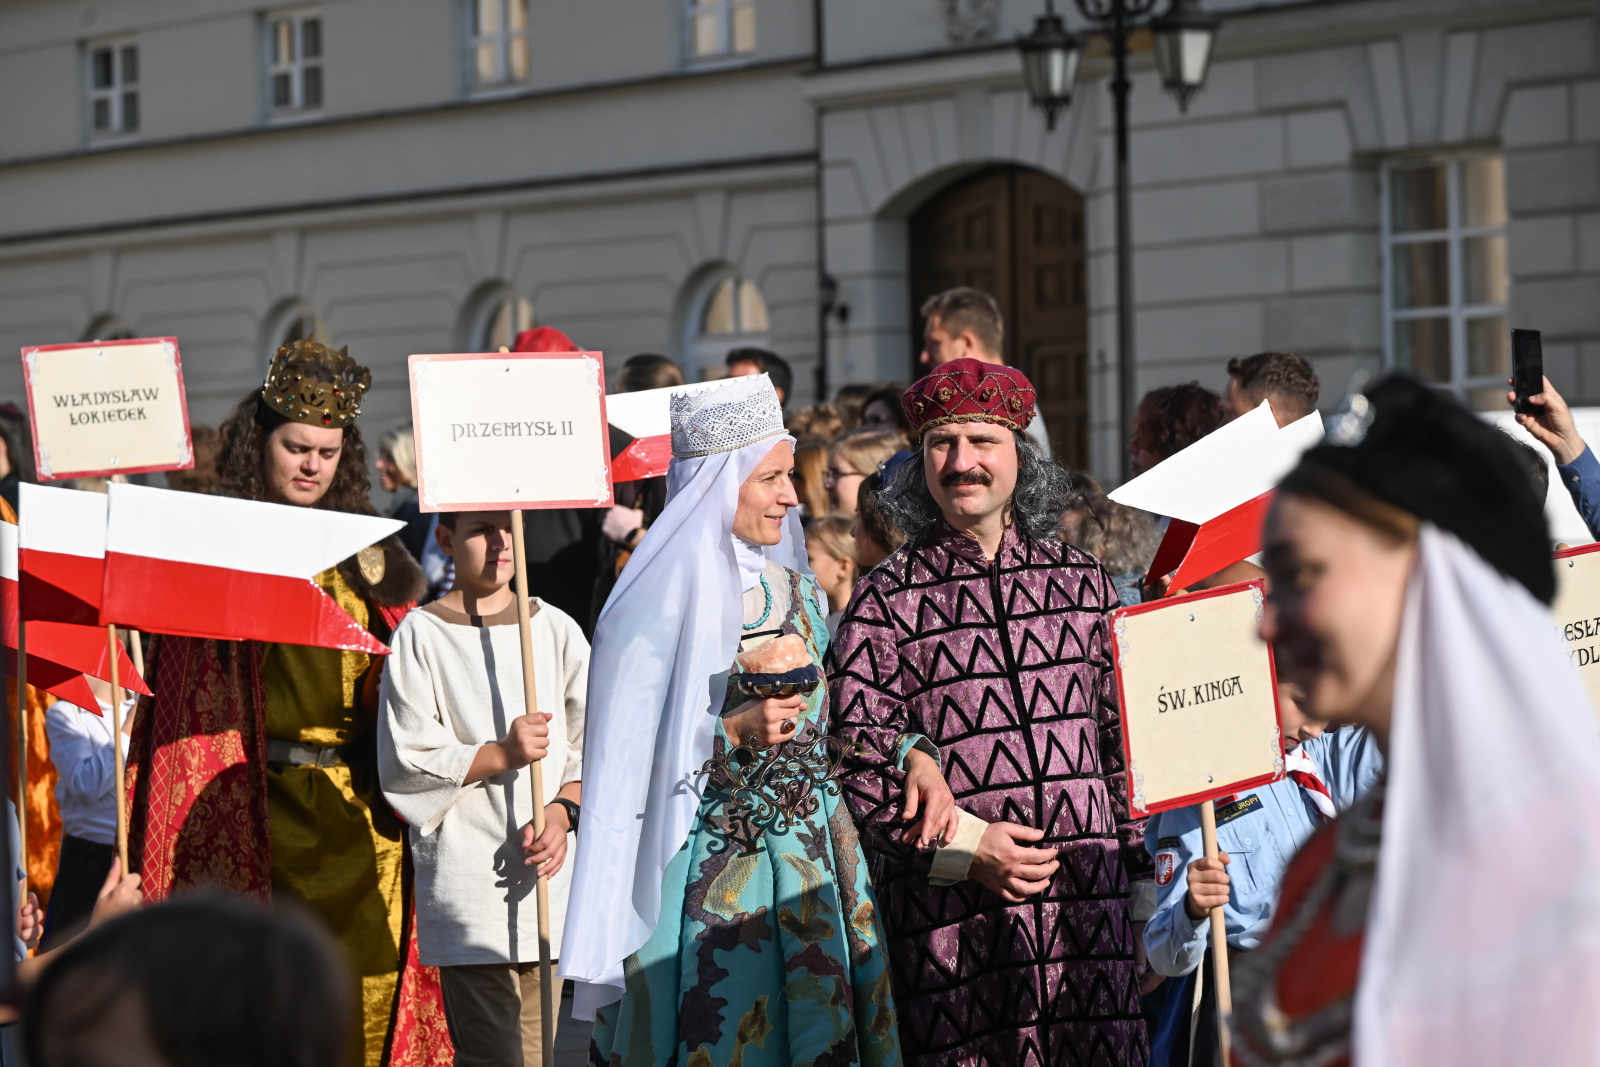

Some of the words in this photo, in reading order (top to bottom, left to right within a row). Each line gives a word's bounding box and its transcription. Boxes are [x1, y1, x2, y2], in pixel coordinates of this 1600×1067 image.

[53, 387, 159, 408] WŁADYSŁAW
[69, 407, 147, 426] ŁOKIETEK
[451, 421, 557, 442] PRZEMYSŁ
[561, 420, 574, 435] II
